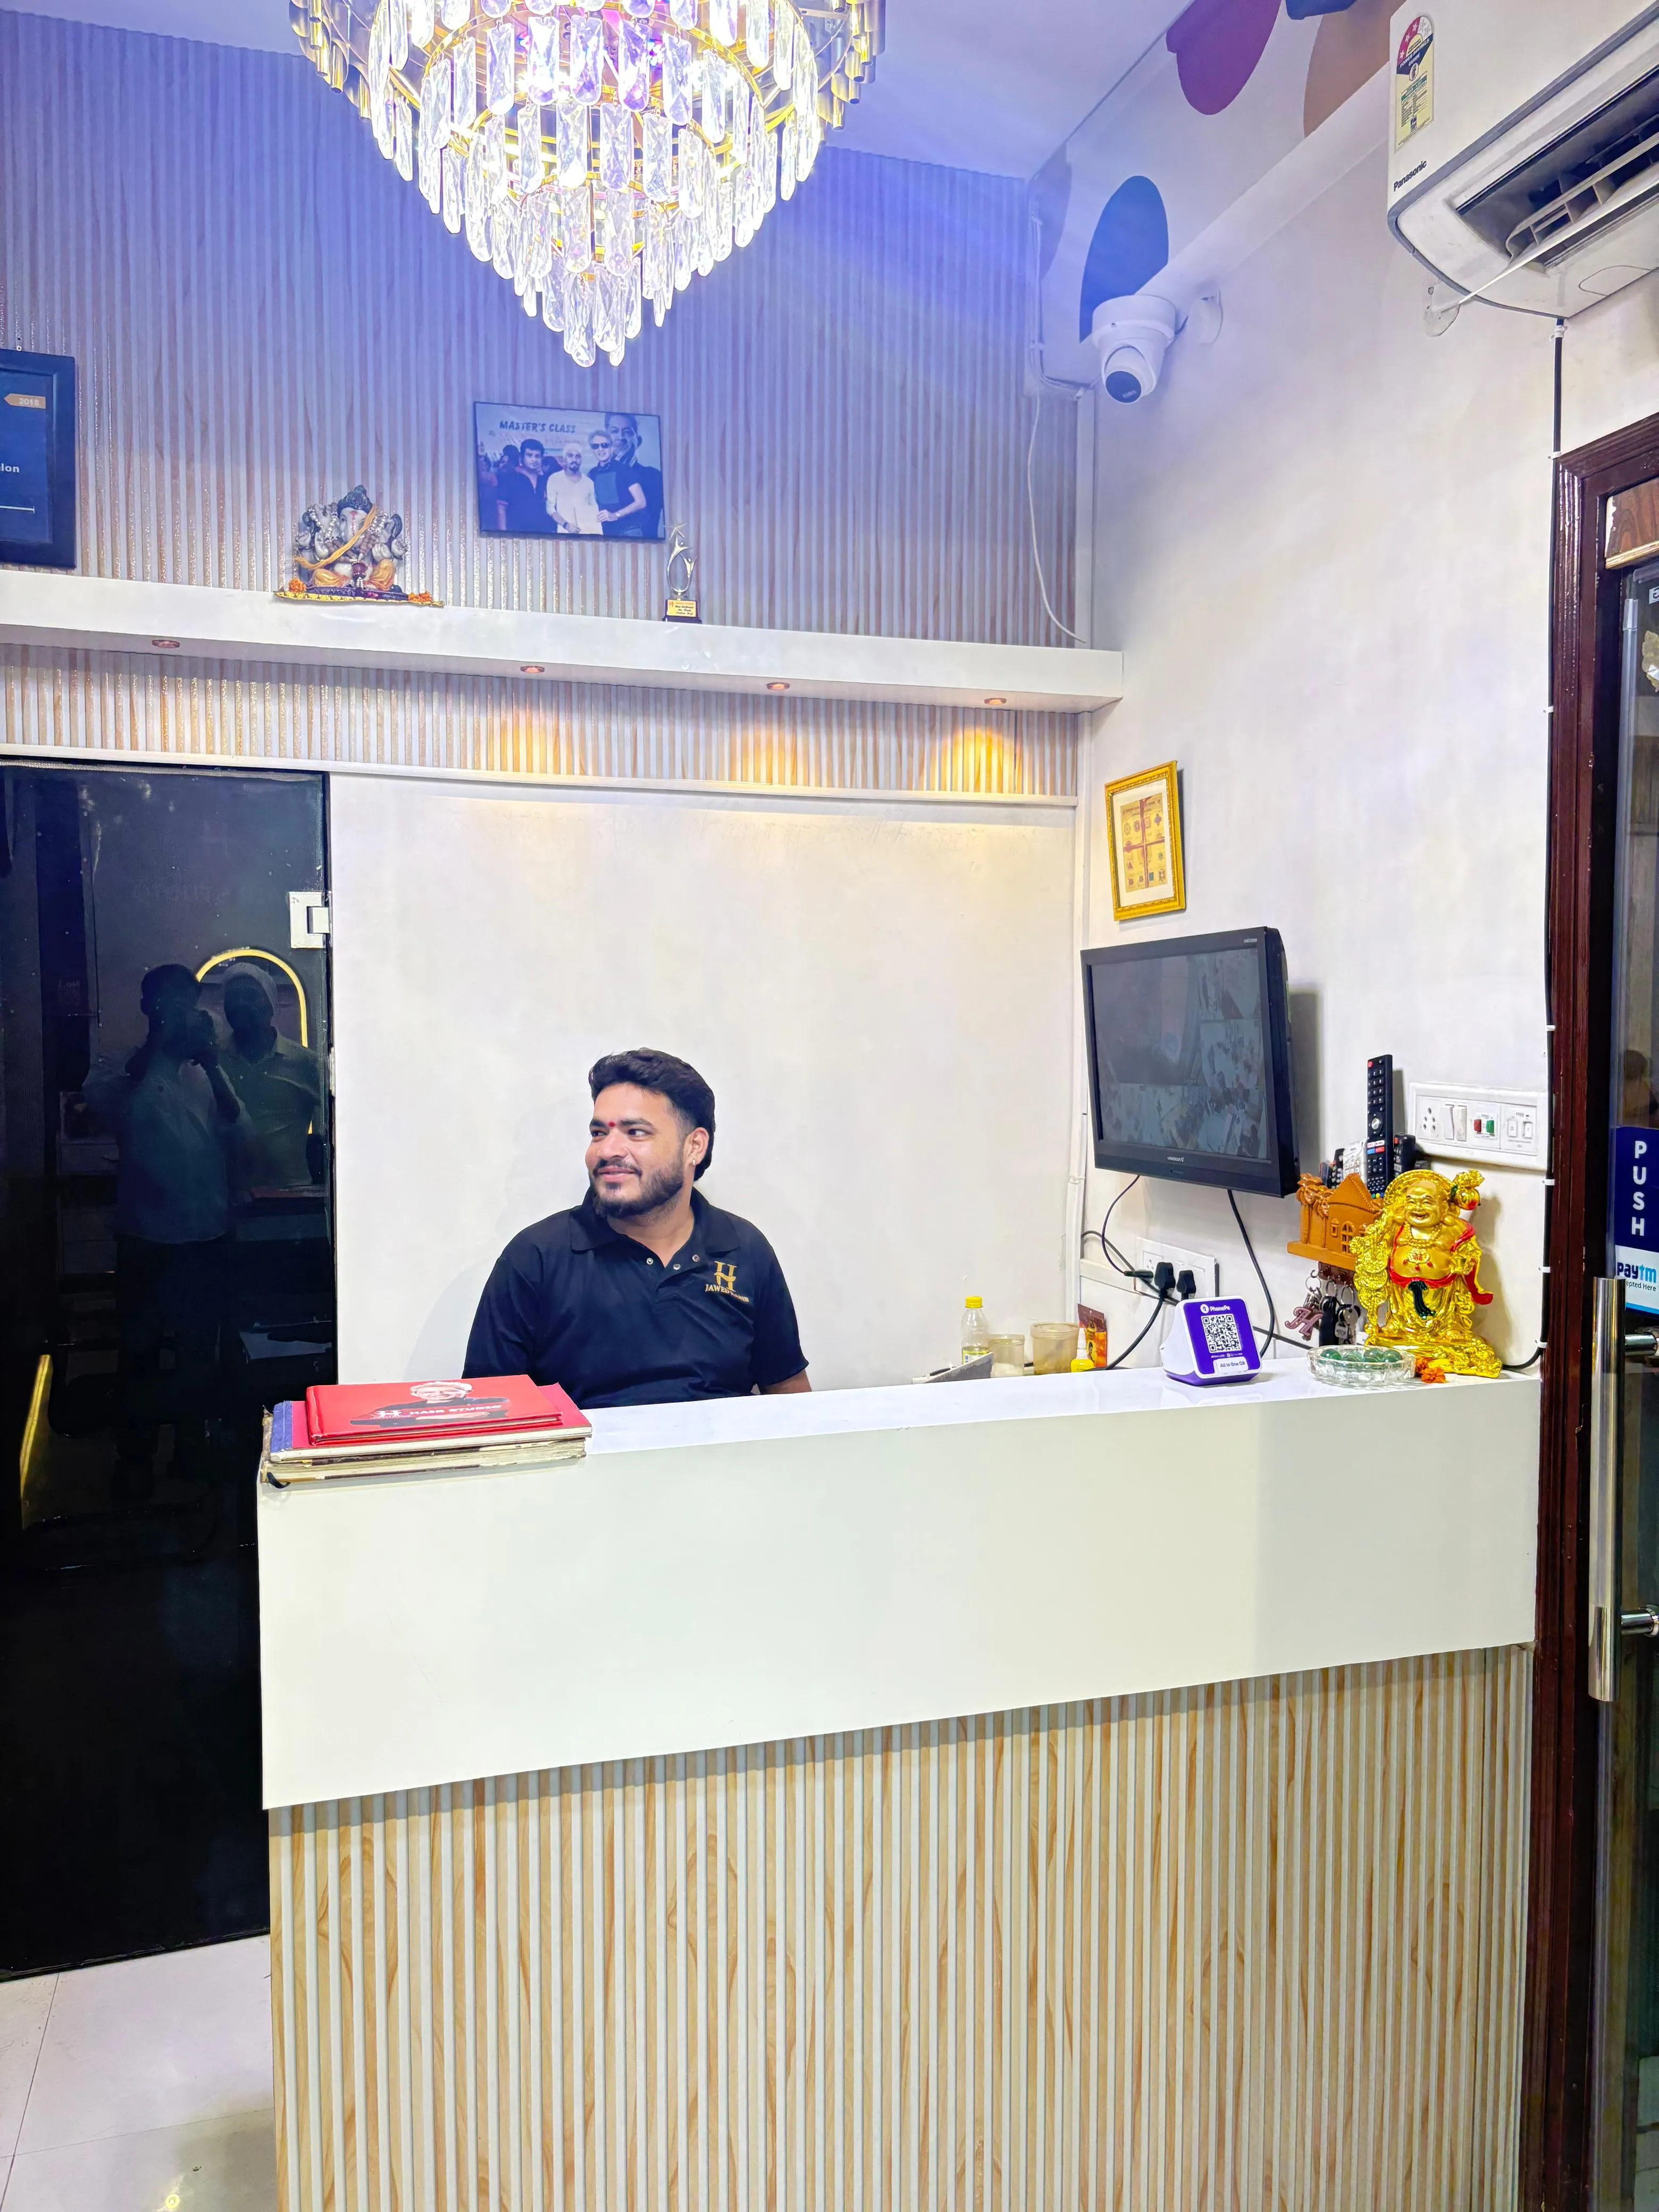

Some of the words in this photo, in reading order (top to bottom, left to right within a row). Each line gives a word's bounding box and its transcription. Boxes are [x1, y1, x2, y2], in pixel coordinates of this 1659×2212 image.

[1393, 160, 1427, 192] Panasonic
[499, 421, 547, 432] MASTER'S
[549, 424, 576, 433] CLASS
[0, 463, 20, 473] lon
[1631, 1140, 1647, 1237] PUSH
[1643, 1283, 1657, 1292] Here
